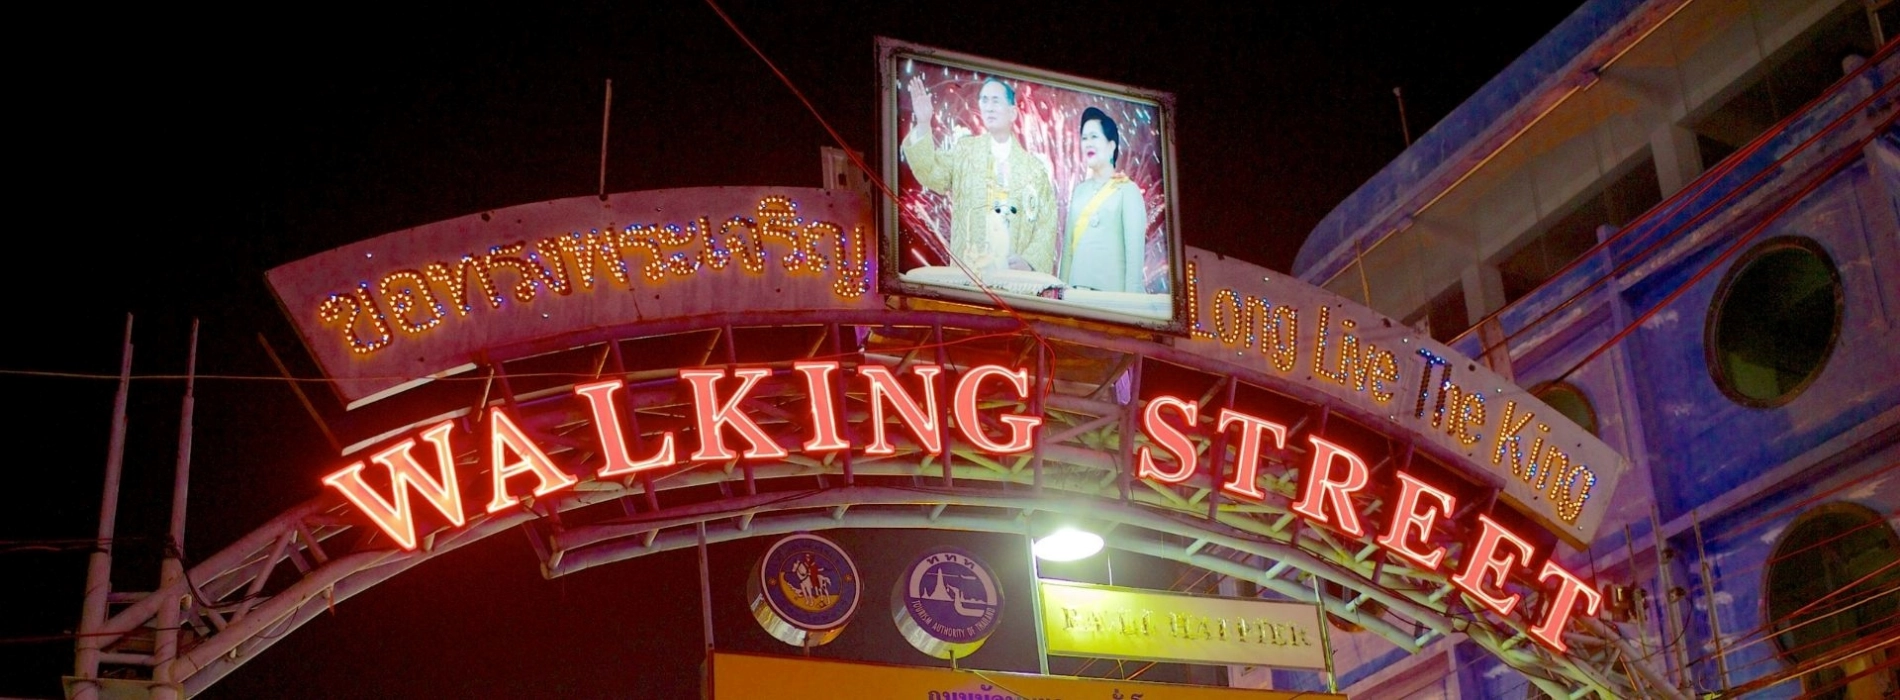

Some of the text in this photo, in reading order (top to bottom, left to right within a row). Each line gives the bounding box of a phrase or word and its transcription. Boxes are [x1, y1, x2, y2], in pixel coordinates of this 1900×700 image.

[319, 195, 869, 353] ขอทรงพระเจริญ
[1186, 260, 1597, 522] Long Live The King
[322, 360, 1602, 654] WALKING STREET
[911, 600, 996, 638] TOURISM AUTHORITY OF THAILAND
